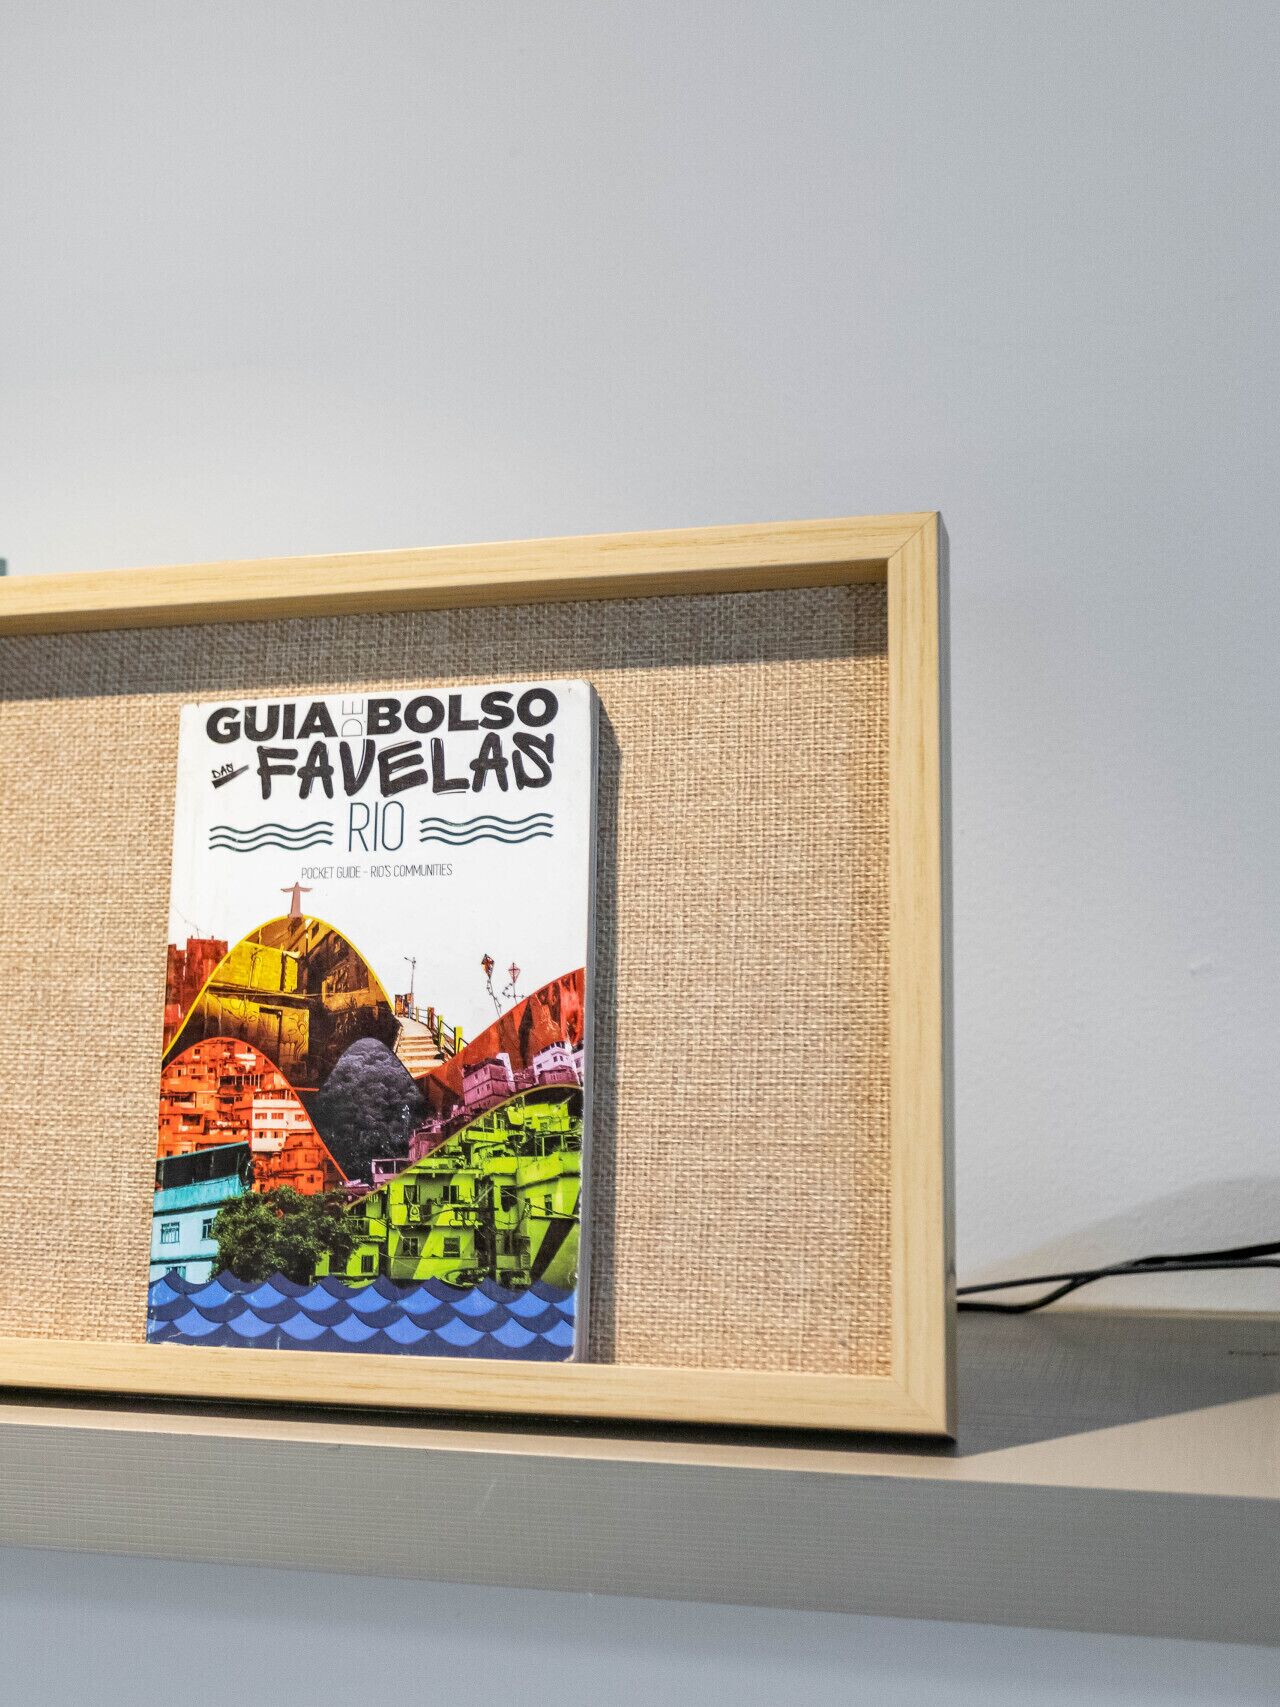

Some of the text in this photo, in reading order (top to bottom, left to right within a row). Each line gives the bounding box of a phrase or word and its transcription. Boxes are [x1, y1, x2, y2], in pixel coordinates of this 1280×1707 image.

[206, 687, 559, 744] GUIA DE BOLSO
[256, 732, 555, 800] FAVELAS
[348, 801, 405, 852] RIO
[301, 866, 334, 880] POCKET
[336, 865, 361, 879] GUIDE
[393, 864, 453, 877] COMMUNITIES
